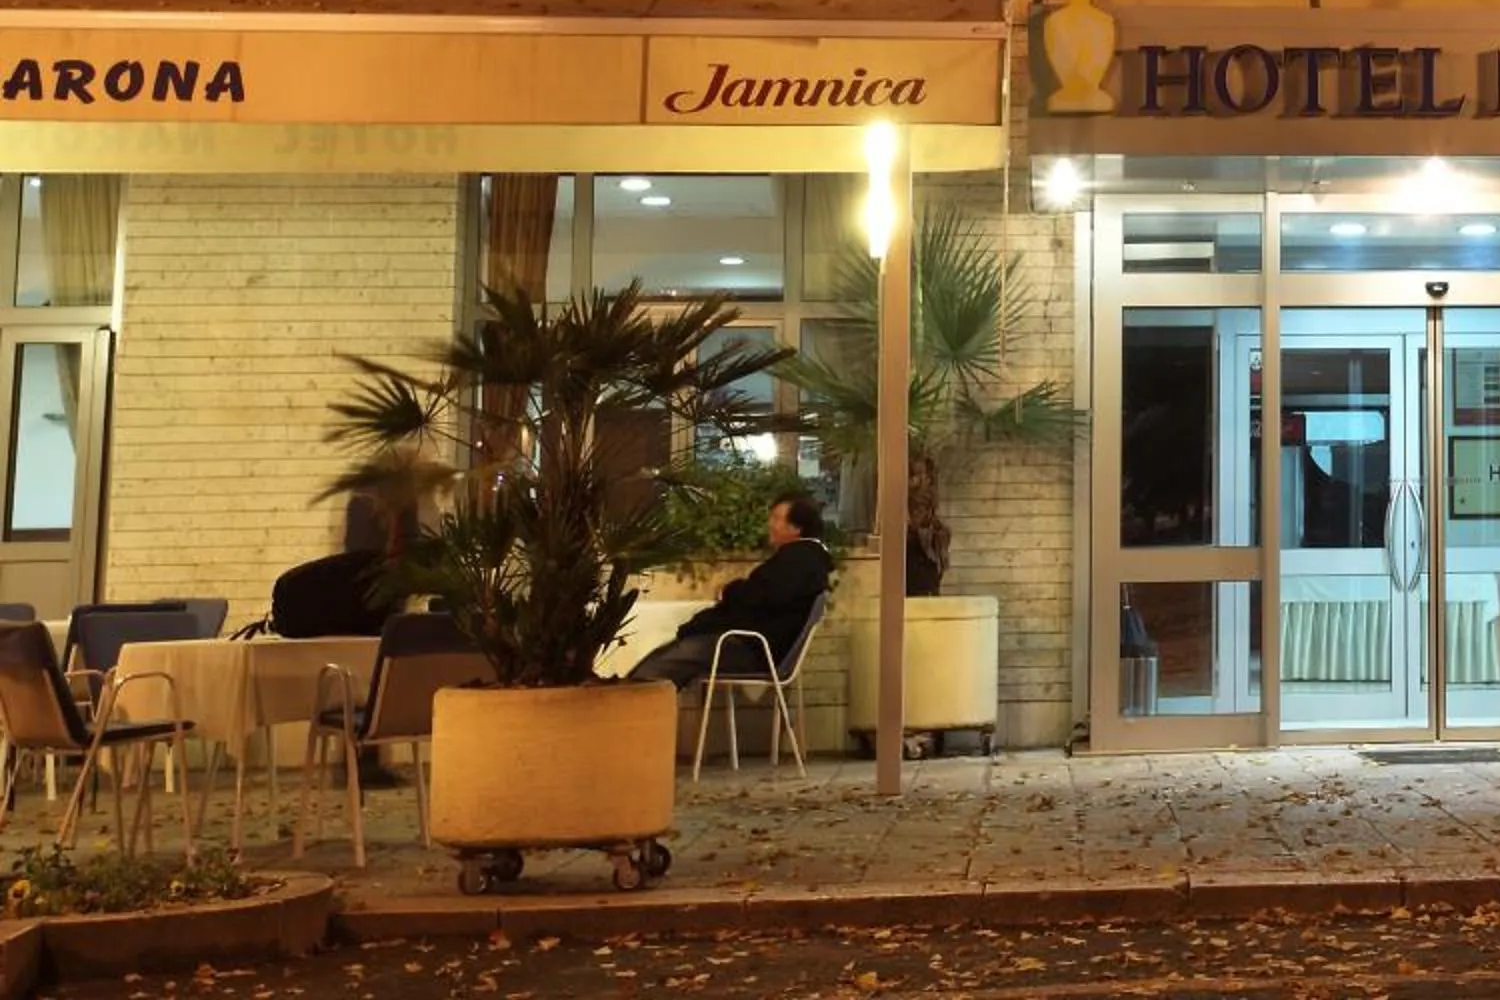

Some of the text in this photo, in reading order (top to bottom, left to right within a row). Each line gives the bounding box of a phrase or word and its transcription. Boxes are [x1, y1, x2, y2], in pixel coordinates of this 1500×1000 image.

[2, 59, 244, 104] ARONA
[663, 63, 927, 115] Jamnica
[1137, 43, 1466, 117] HOTEL
